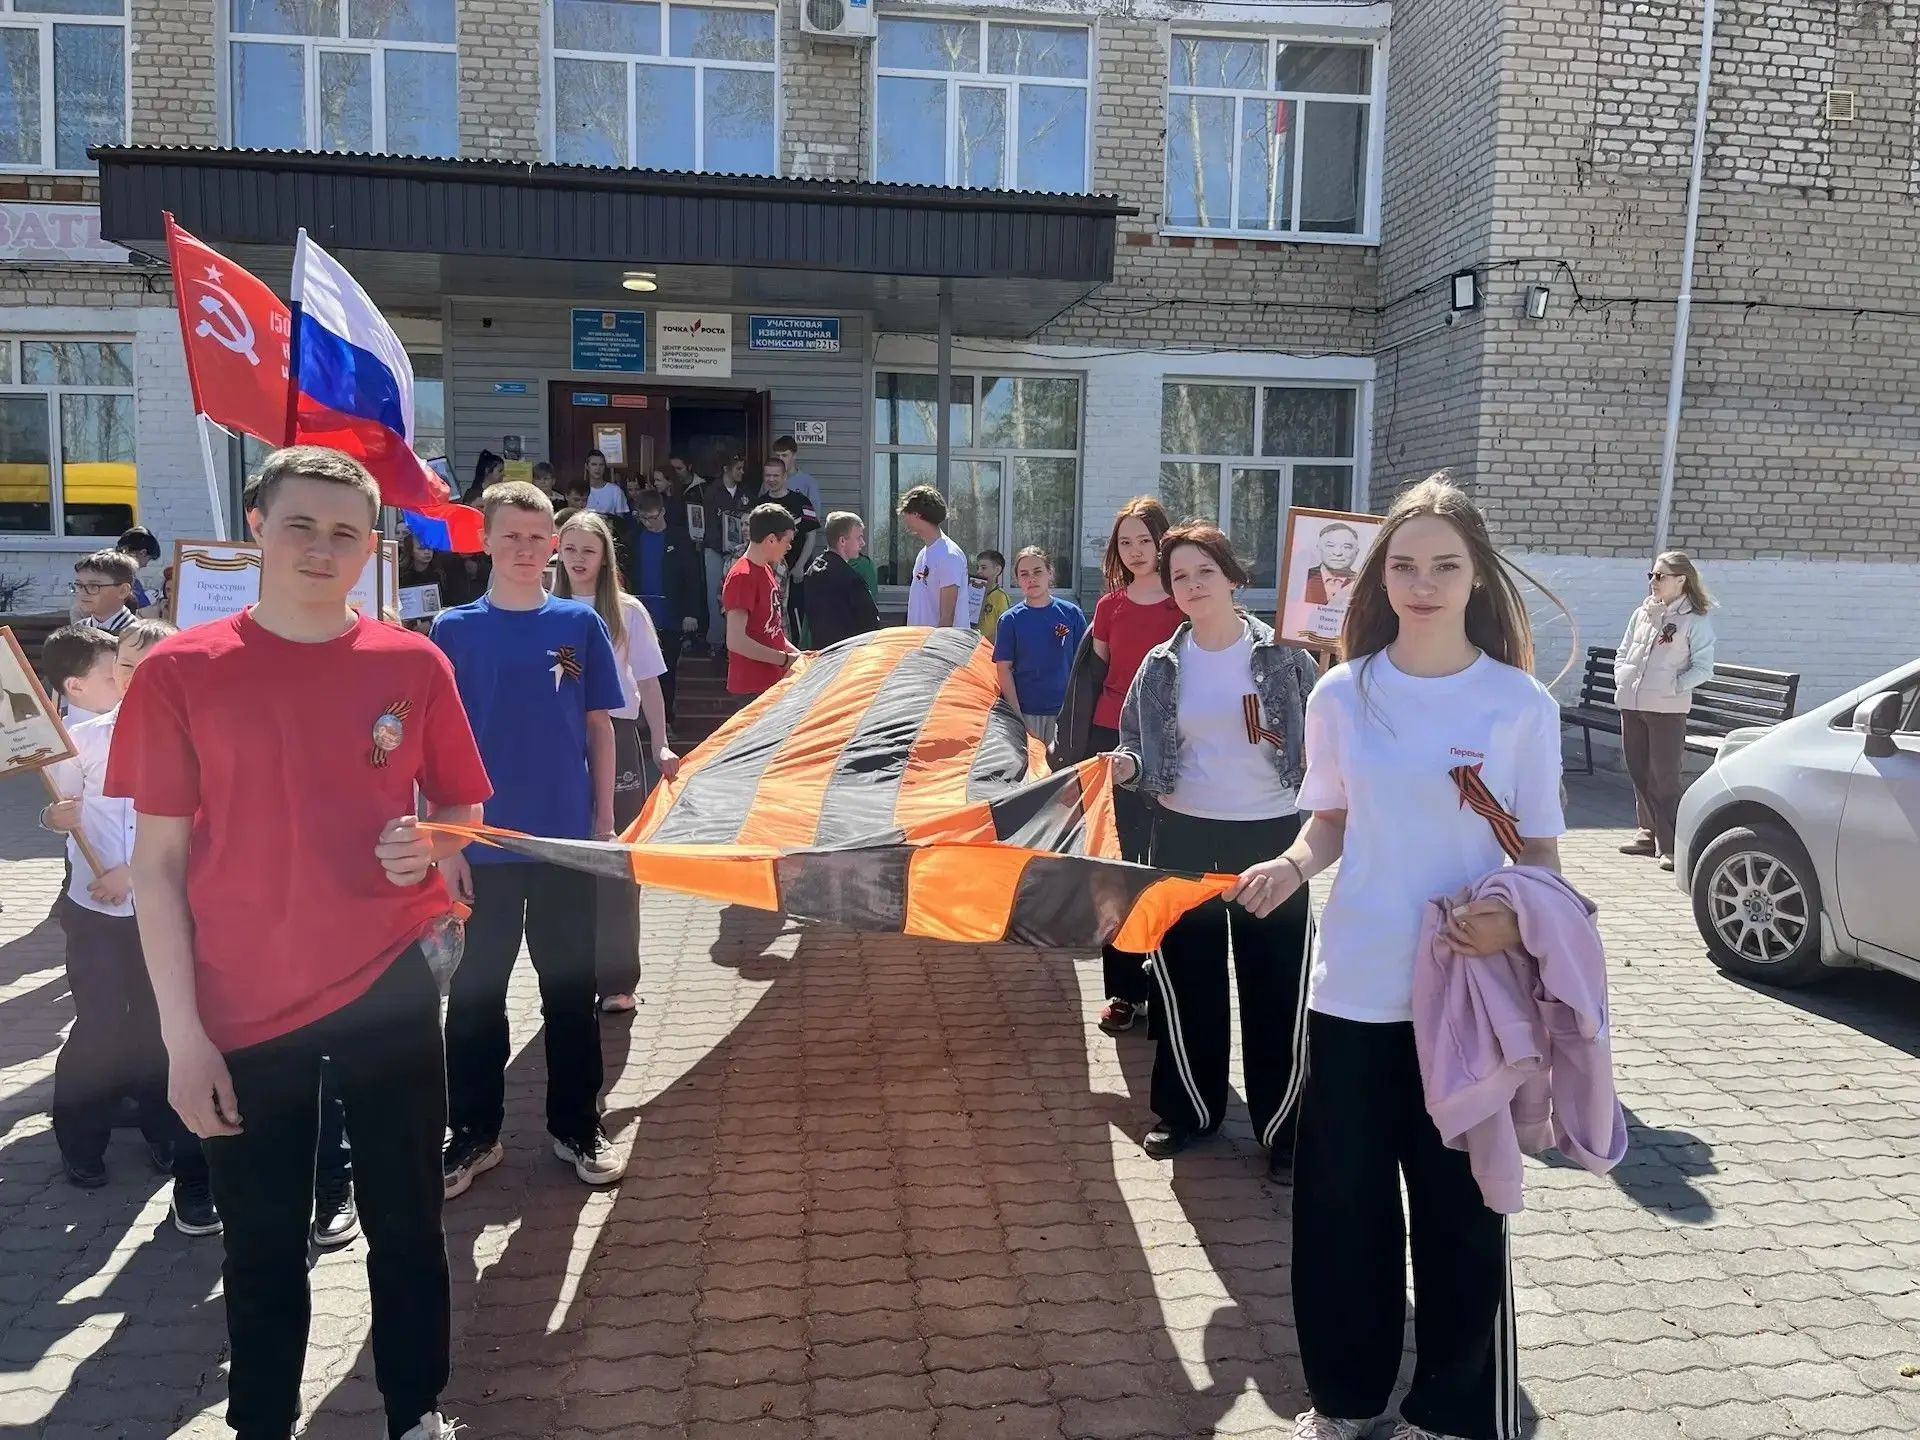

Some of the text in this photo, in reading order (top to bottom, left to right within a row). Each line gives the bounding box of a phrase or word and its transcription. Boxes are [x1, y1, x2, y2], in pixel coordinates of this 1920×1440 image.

[767, 320, 823, 328] УЧАСТКОВАЯ
[758, 329, 831, 338] ИЗБИРАТЕЛЬНАЯ
[756, 339, 804, 348] КОМИССИЯ
[796, 422, 808, 432] НЕ
[197, 581, 245, 592] Проскурин
[450, 747, 485, 759] Первые
